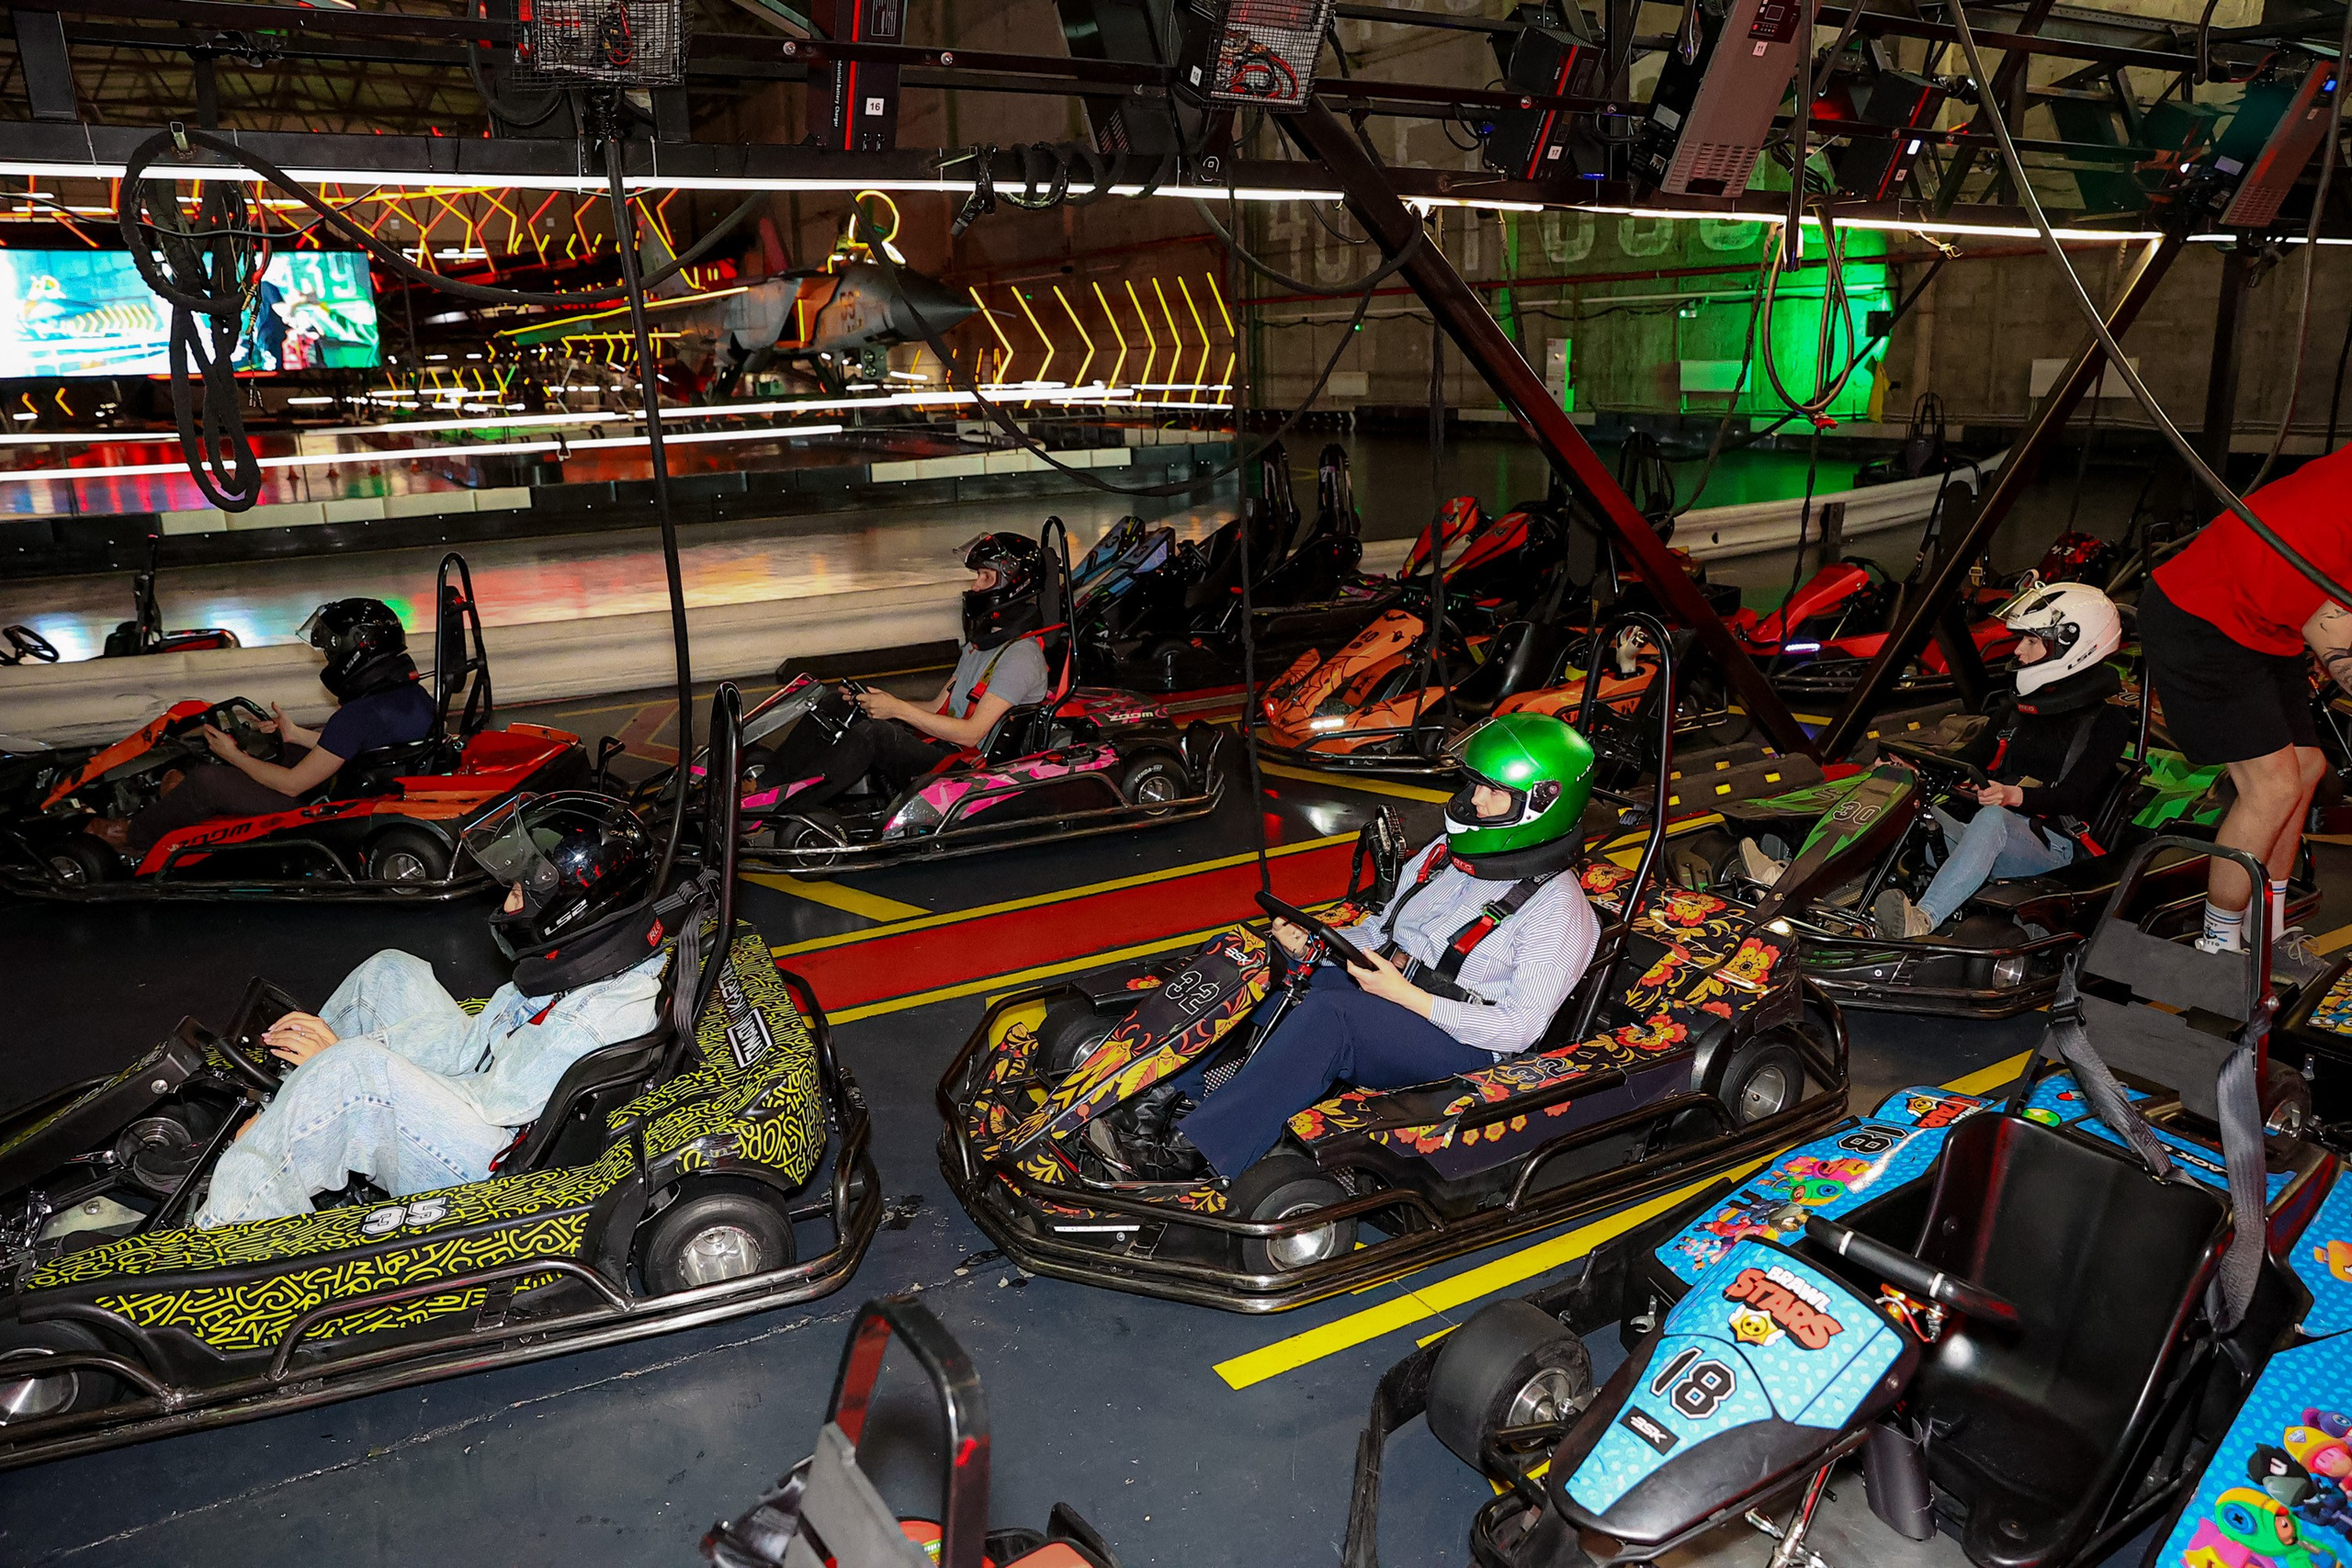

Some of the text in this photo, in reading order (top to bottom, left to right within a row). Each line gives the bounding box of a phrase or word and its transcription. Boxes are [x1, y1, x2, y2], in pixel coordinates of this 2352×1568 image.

[833, 84, 842, 104] Battery
[869, 102, 880, 111] 16
[832, 106, 841, 127] Charger
[1831, 800, 1883, 826] 30
[544, 898, 589, 936] LS2
[1165, 970, 1220, 1015] 32
[1506, 1057, 1579, 1085] 32
[1838, 1124, 1909, 1155] 18
[361, 1197, 447, 1235] 35
[1765, 1265, 1833, 1314] BRAWL
[1722, 1268, 1845, 1350] STARS
[1649, 1346, 1738, 1420] 18
